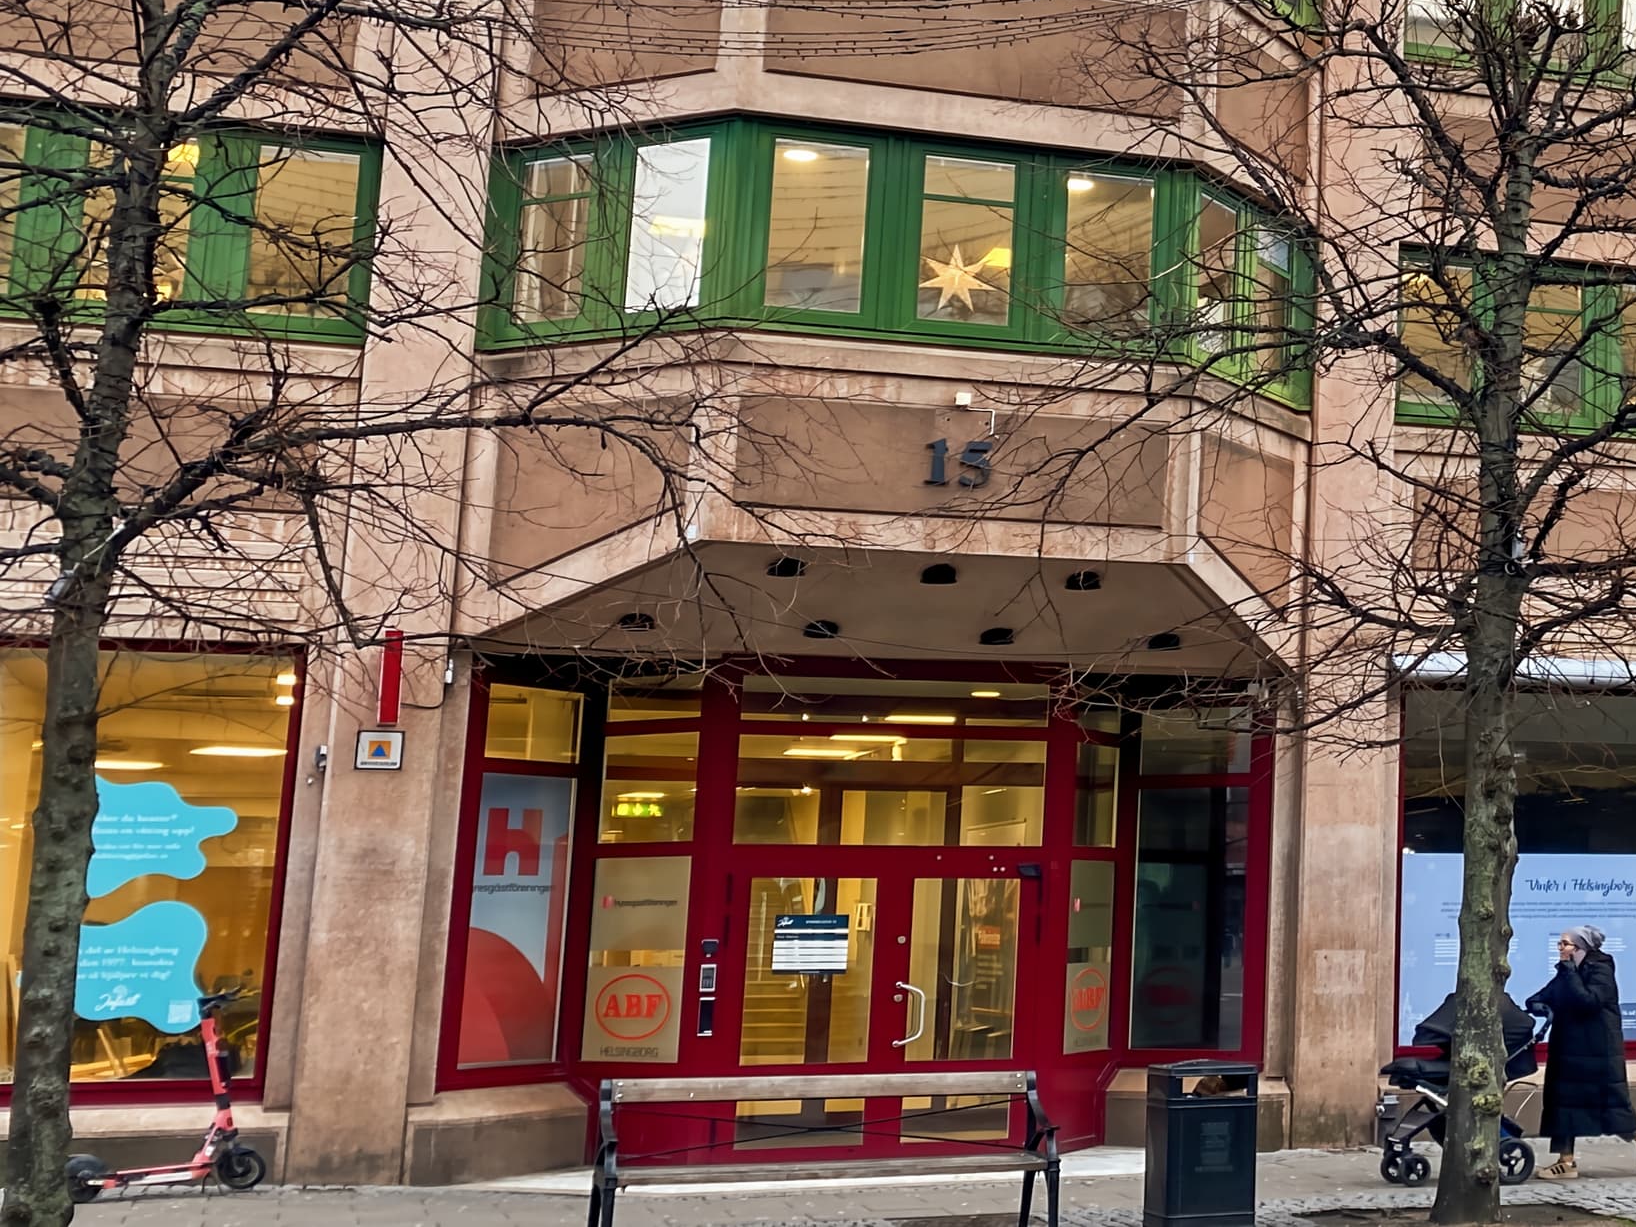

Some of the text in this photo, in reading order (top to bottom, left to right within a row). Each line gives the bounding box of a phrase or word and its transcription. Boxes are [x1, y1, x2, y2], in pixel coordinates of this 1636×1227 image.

[924, 438, 994, 487] 15
[1524, 878, 1559, 893] Vinter
[1571, 878, 1634, 897] Helsingborg
[602, 993, 664, 1018] ABF
